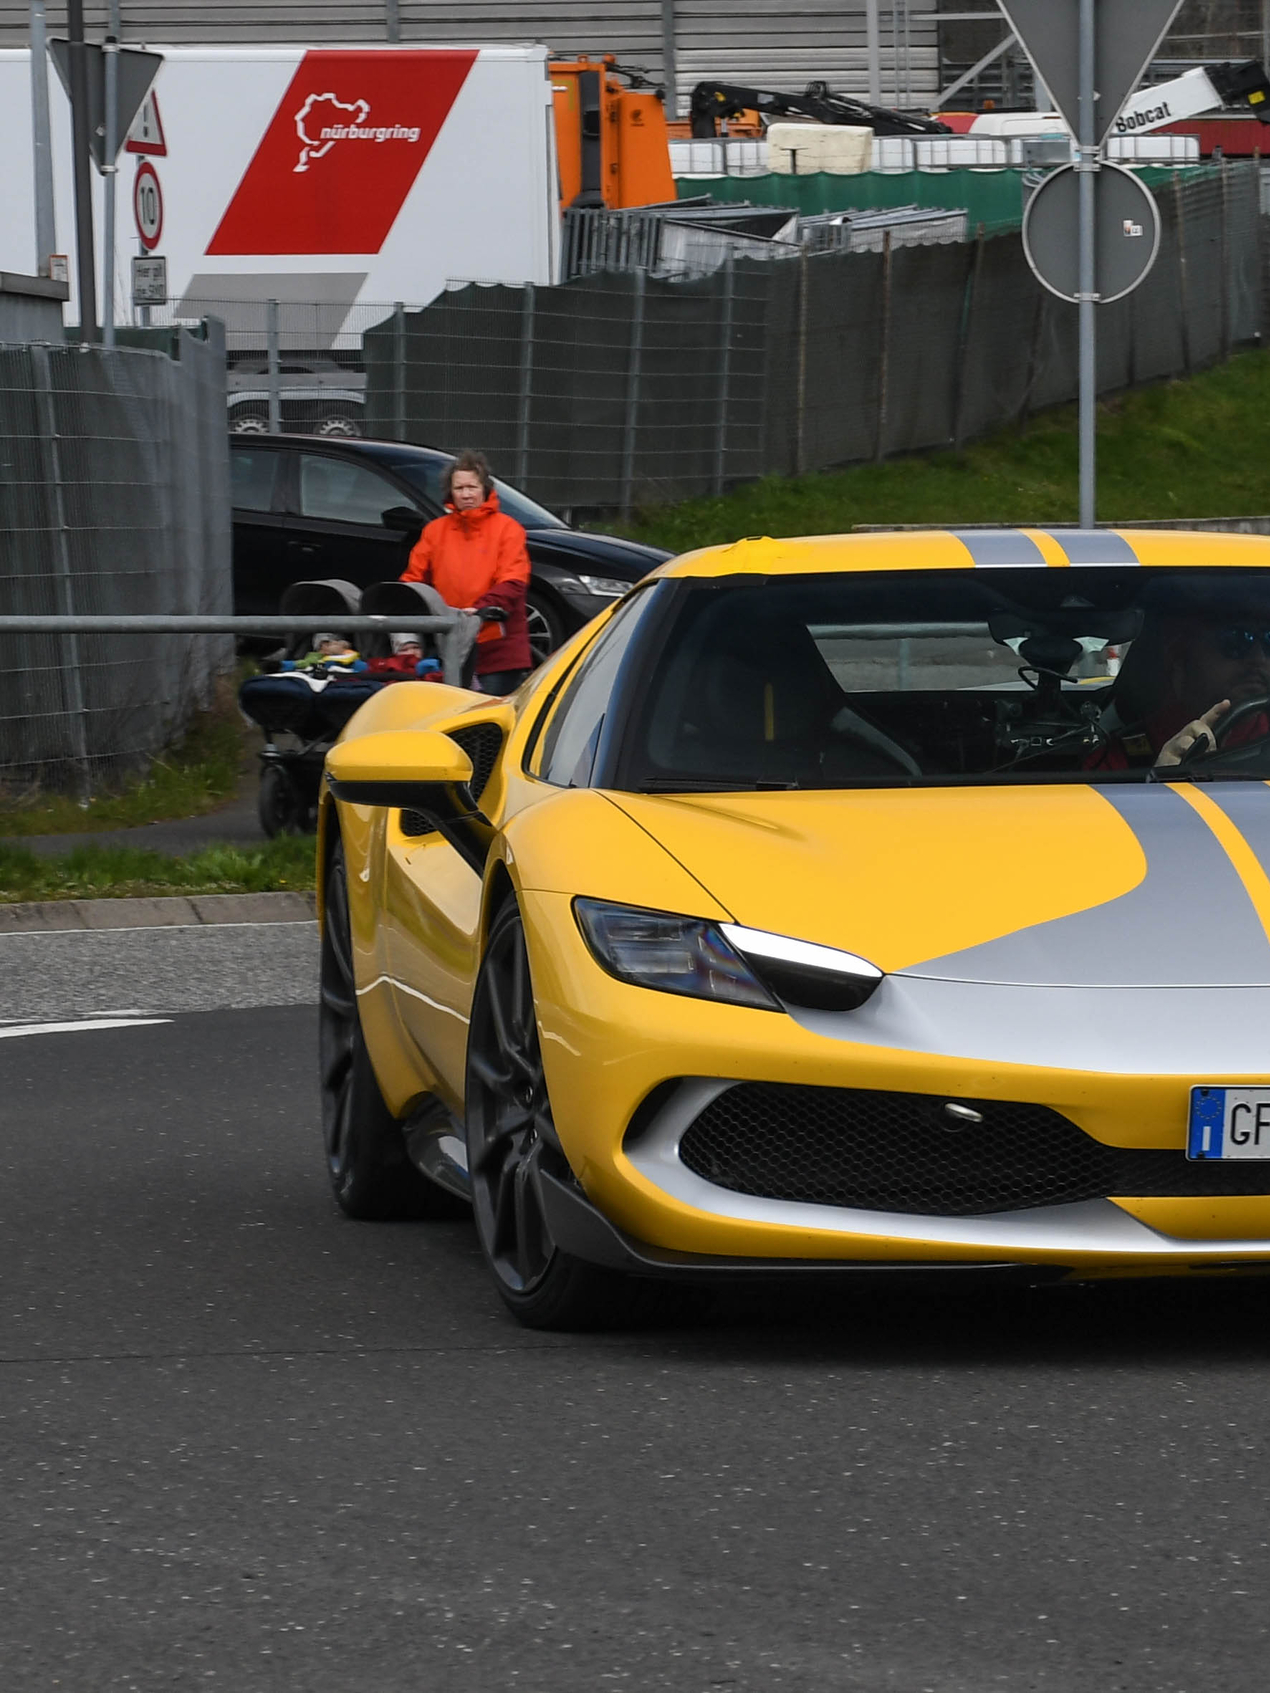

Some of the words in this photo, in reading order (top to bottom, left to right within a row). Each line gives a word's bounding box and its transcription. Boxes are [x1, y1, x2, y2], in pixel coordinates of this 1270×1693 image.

[1116, 102, 1171, 132] Bobcat
[320, 124, 421, 142] nürburgring
[140, 186, 156, 226] 10
